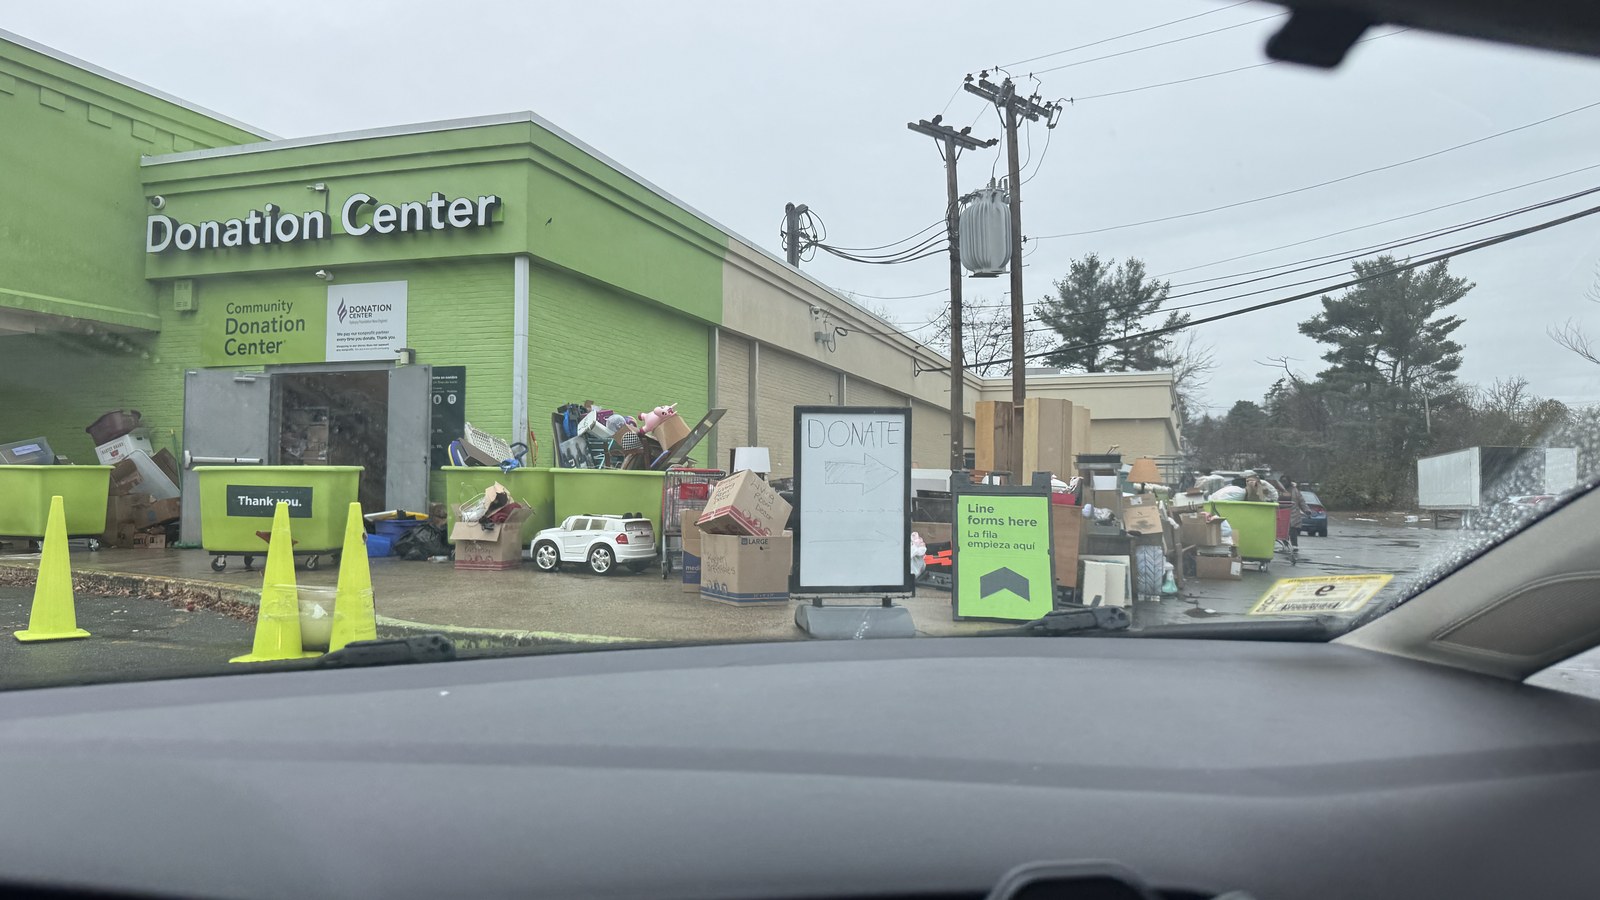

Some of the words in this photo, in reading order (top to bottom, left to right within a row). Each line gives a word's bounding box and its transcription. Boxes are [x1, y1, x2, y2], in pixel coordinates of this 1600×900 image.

[146, 203, 327, 253] Donation
[341, 192, 499, 236] Center
[225, 299, 294, 315] Community
[349, 303, 392, 314] DONATION
[225, 316, 306, 335] Donation
[224, 337, 284, 356] Center
[807, 418, 903, 449] DONATE
[237, 495, 274, 507] Thank
[967, 503, 995, 514] Line
[967, 515, 1005, 526] forms
[1008, 515, 1038, 527] here
[967, 530, 980, 539] La
[981, 529, 998, 539] fila
[967, 540, 1011, 552] empieza
[1012, 540, 1036, 552] aquí
